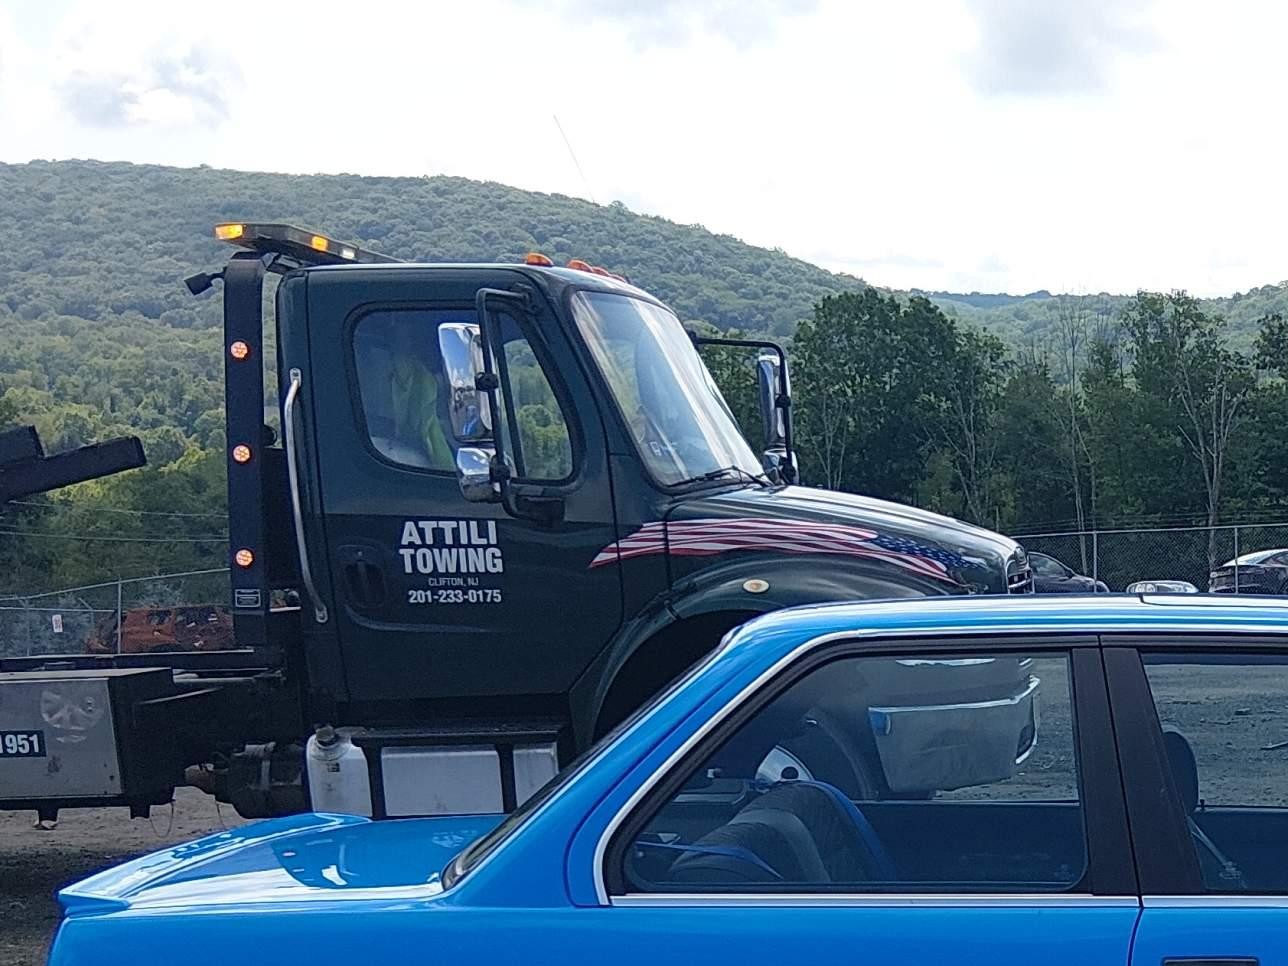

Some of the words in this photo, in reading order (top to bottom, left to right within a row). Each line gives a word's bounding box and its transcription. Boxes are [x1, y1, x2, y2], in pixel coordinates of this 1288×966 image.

[401, 520, 498, 545] ATTILI
[399, 547, 504, 573] TOWING
[428, 577, 467, 587] CLIFTON,
[467, 577, 479, 586] NJ
[408, 589, 502, 603] 201-233-0175
